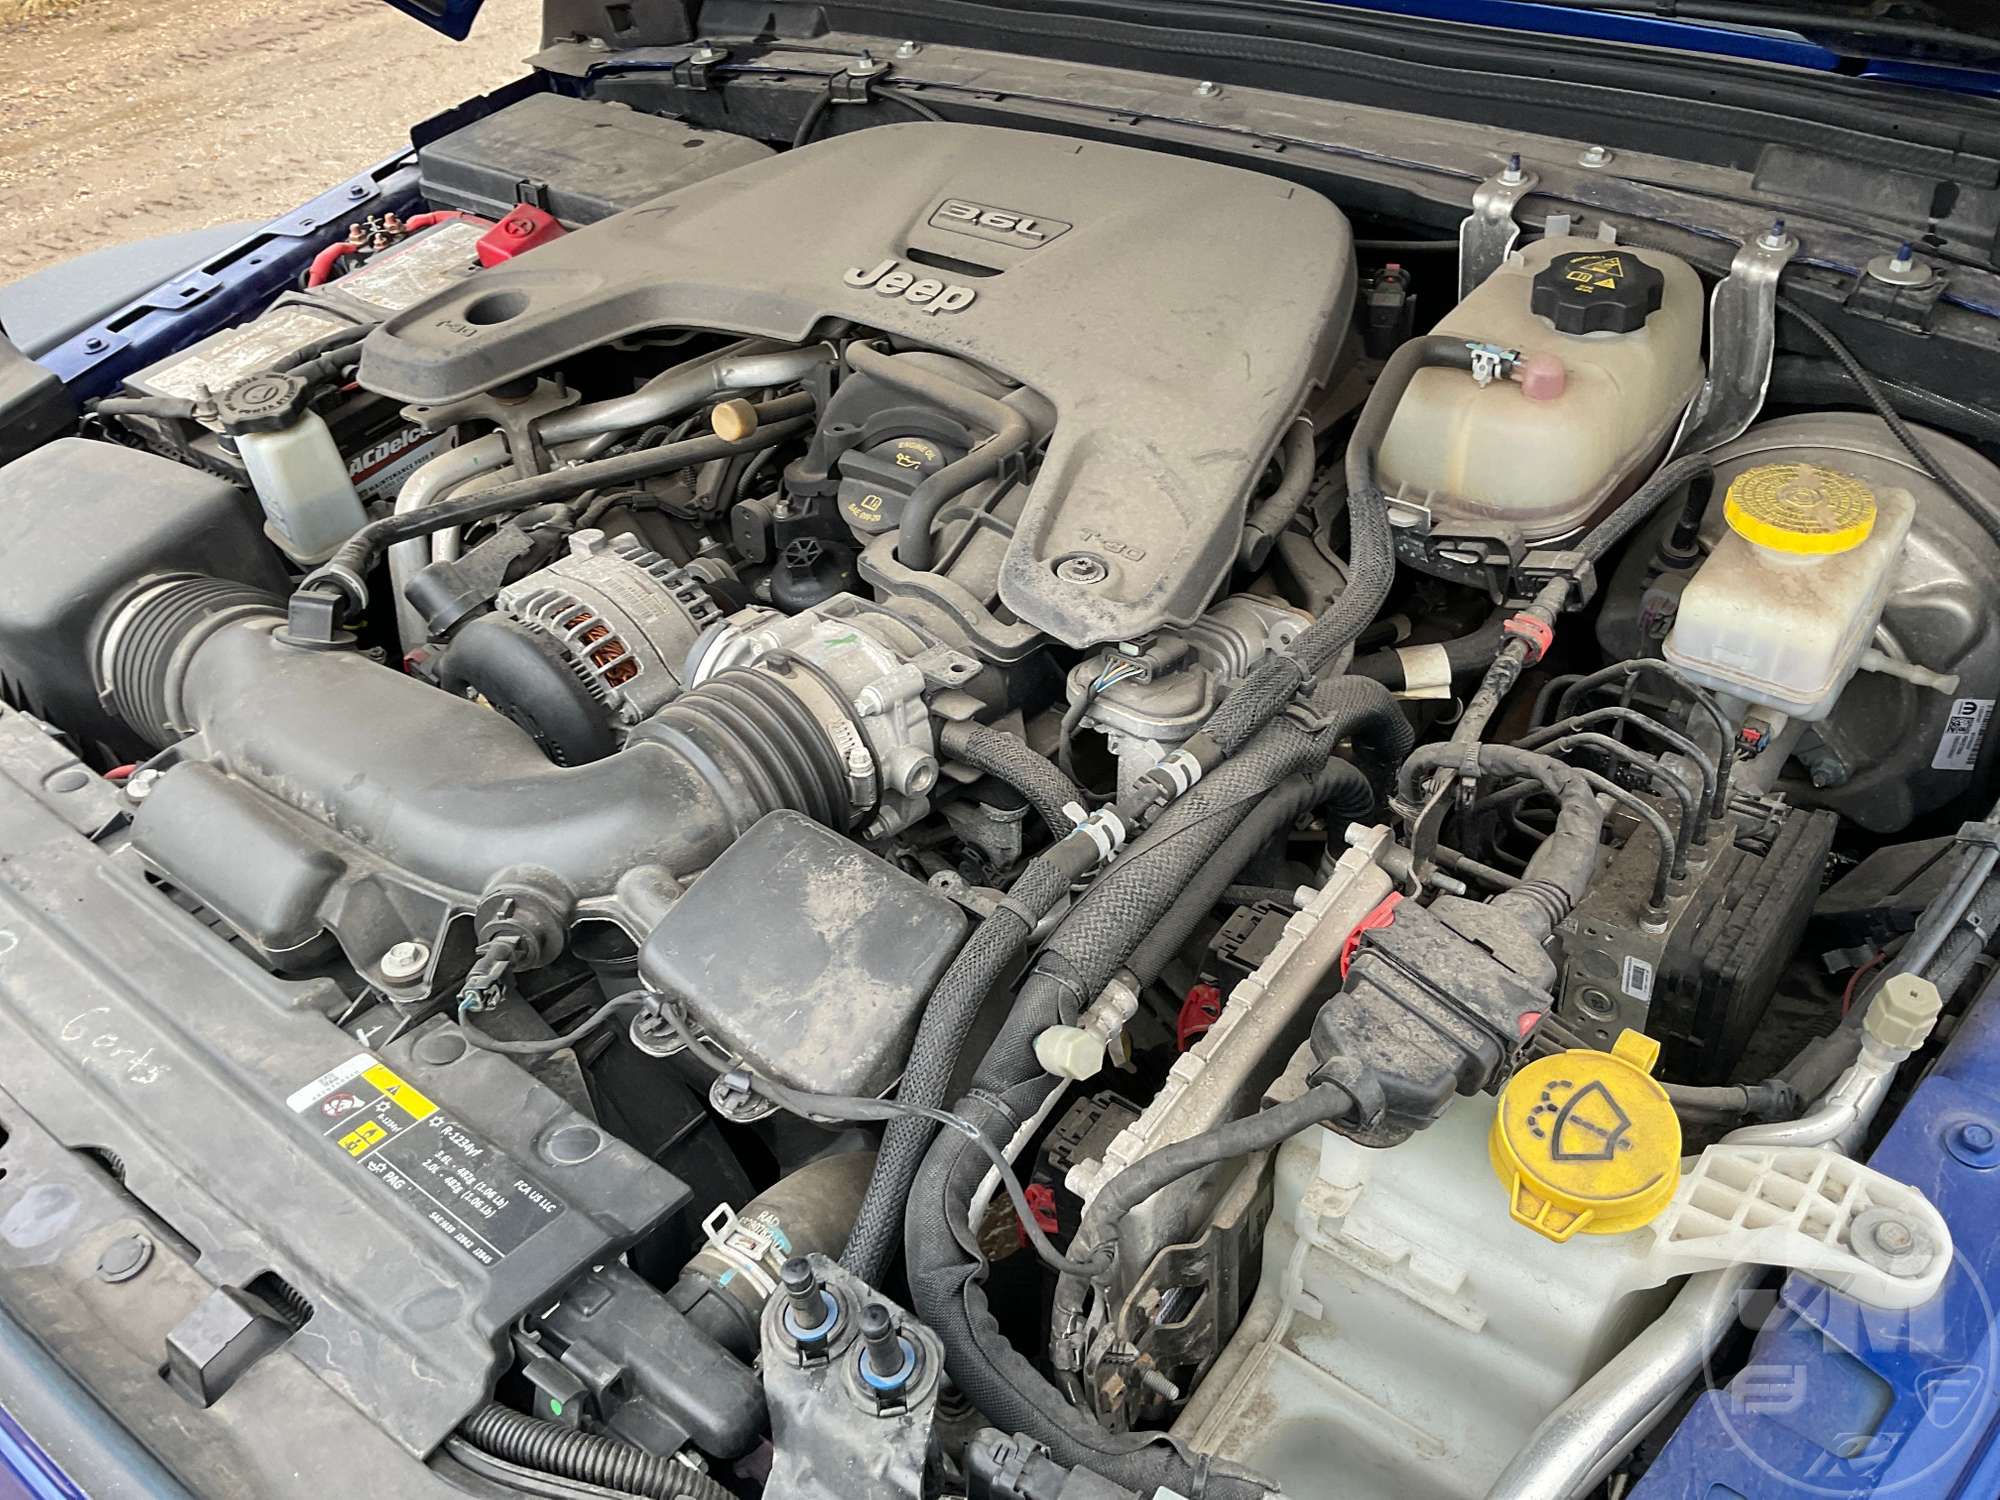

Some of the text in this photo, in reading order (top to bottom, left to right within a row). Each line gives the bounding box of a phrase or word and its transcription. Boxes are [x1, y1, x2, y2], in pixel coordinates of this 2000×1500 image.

[939, 202, 1045, 241] 3.6L
[843, 259, 977, 316] Jeep
[1079, 527, 1147, 562] T-30
[440, 1126, 484, 1157] R-1234yf
[383, 1171, 406, 1190] PAG
[444, 1176, 464, 1194] 482g
[460, 1190, 485, 1209] (1.06
[513, 1179, 532, 1195] FCA
[538, 1198, 557, 1213] LLC
